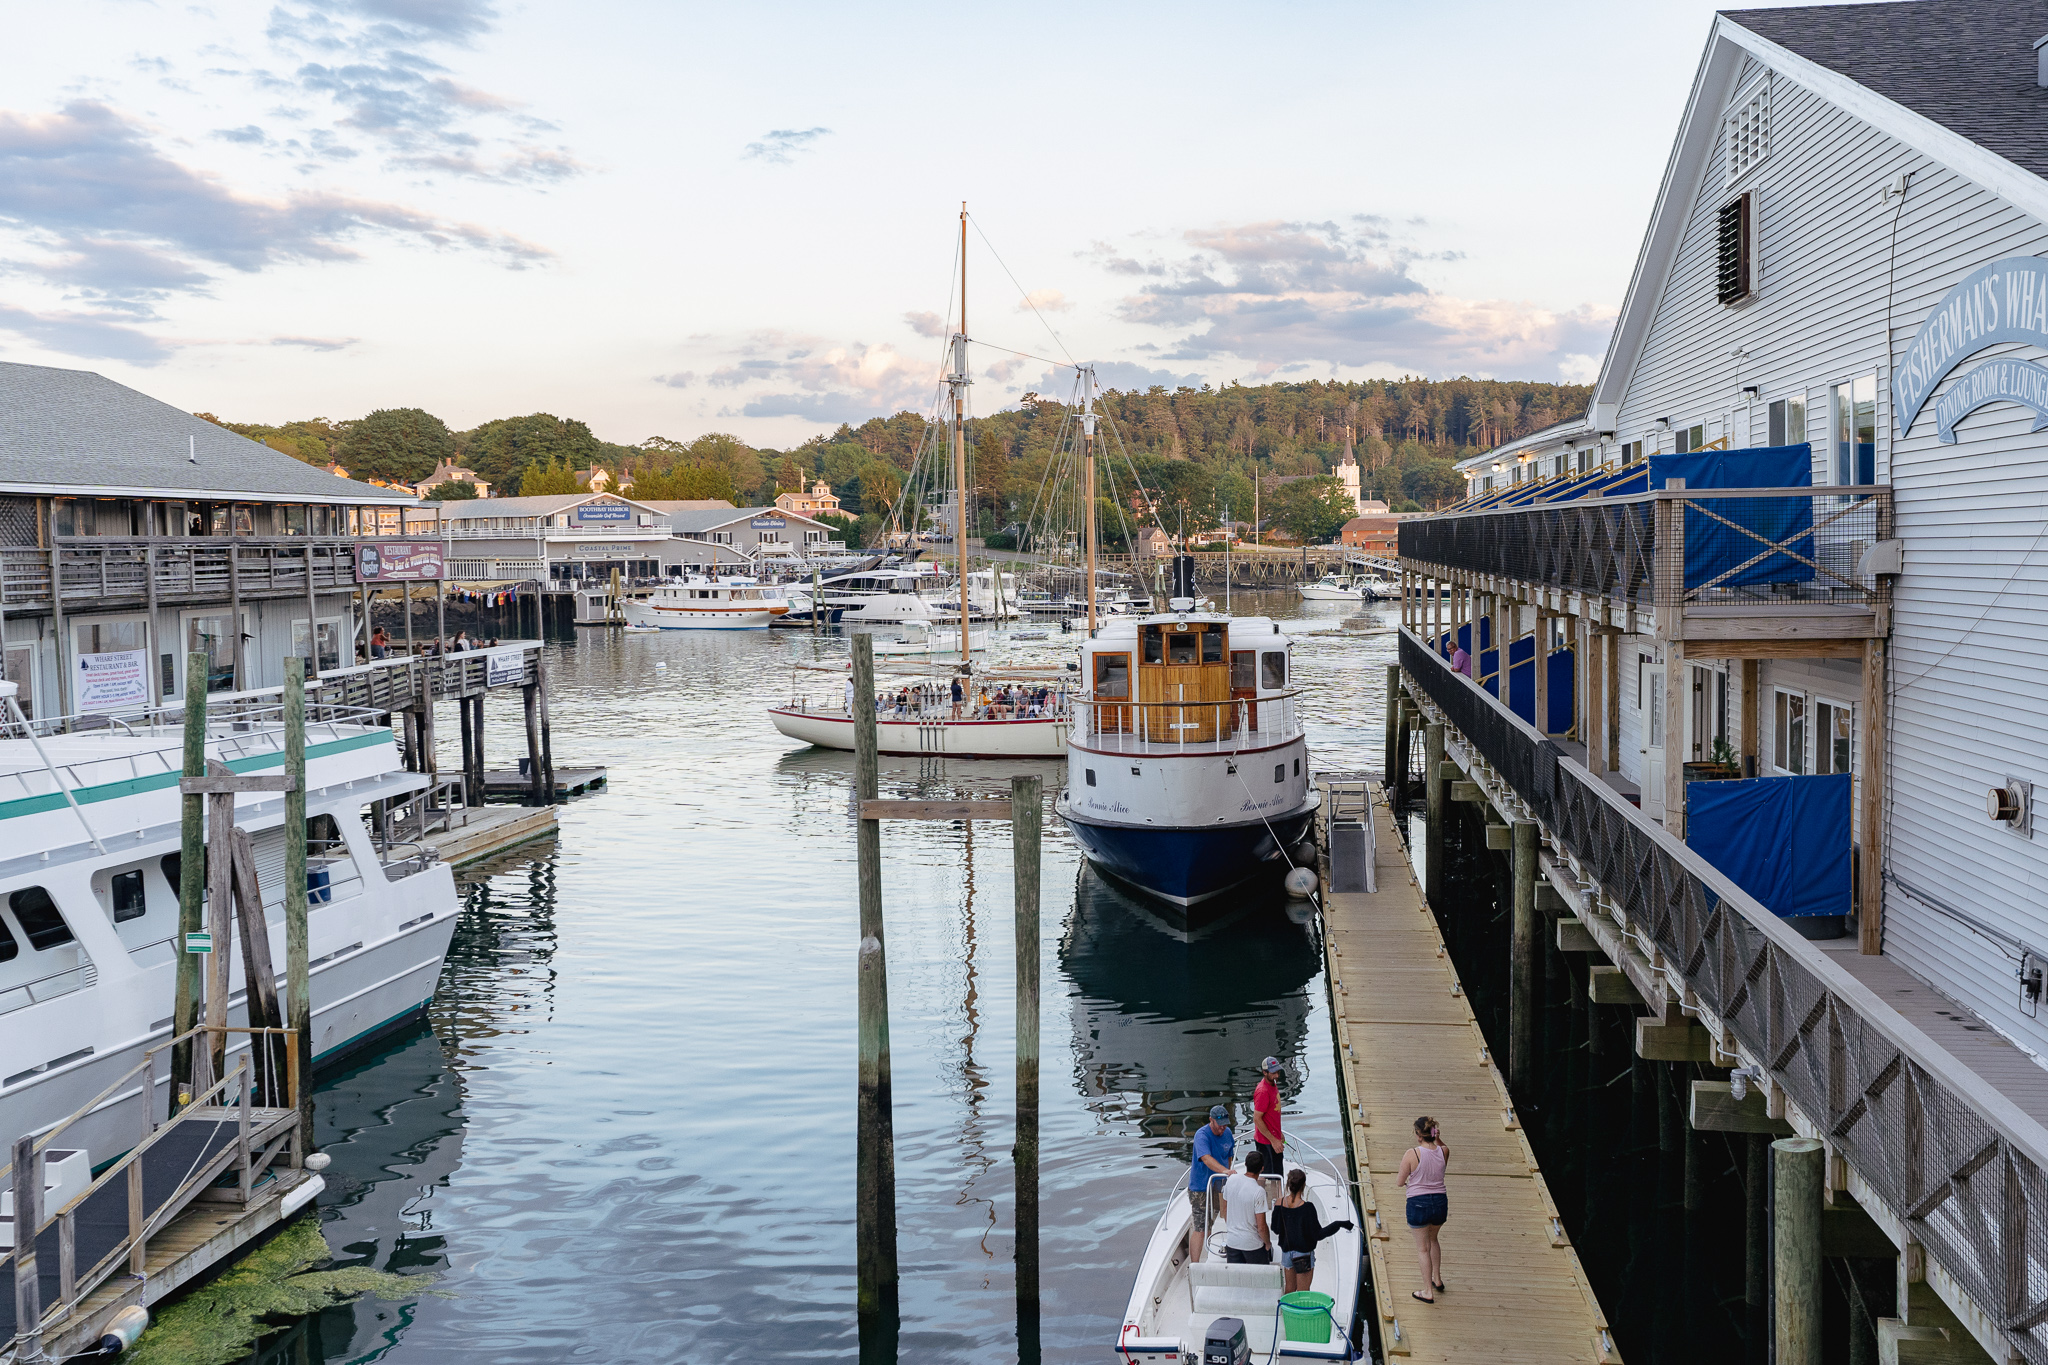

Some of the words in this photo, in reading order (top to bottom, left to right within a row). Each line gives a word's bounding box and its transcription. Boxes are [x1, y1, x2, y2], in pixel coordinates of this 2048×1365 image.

[1897, 273, 2000, 420] FISHERMAN'S
[1938, 379, 1970, 431] DINING
[1971, 364, 1999, 402] ROOM
[2000, 363, 2008, 394] &
[2010, 364, 2048, 410] LOUNG
[362, 548, 377, 561] Mine
[384, 545, 412, 555] RESTAURANT
[361, 561, 379, 576] Oyster
[381, 557, 394, 571] Raw
[394, 560, 404, 571] Bar
[405, 557, 410, 569] &
[1109, 800, 1131, 814] Alice
[1211, 1355, 1228, 1364] 90
